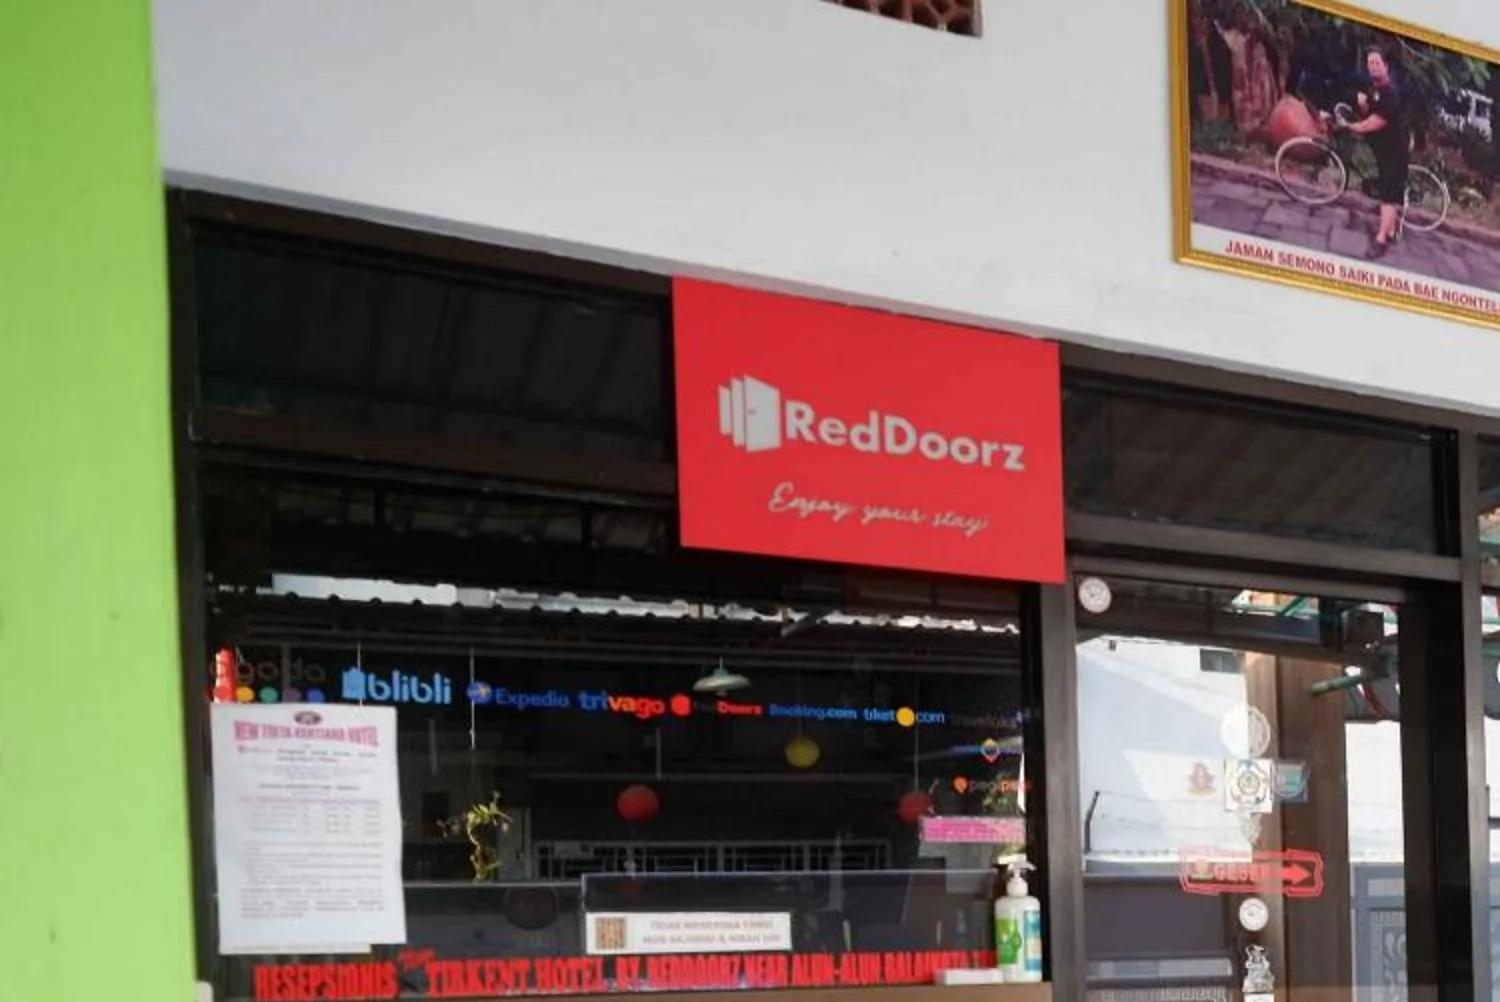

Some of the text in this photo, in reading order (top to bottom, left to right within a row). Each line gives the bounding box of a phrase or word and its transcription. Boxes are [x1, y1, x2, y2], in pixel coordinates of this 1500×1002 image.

[1225, 239, 1274, 262] JAMAN
[1277, 251, 1335, 276] SEMONO
[1339, 265, 1375, 284] SAIKI
[1377, 273, 1411, 292] PADA
[784, 399, 1026, 471] RedDoorz
[768, 481, 989, 537] Enjoy your stay
[367, 669, 451, 704] blibli
[578, 690, 666, 718] trivago
[769, 703, 858, 720] Booking.com
[255, 961, 399, 1002] RESEPSIONIS
[534, 955, 607, 993] HOTEL
